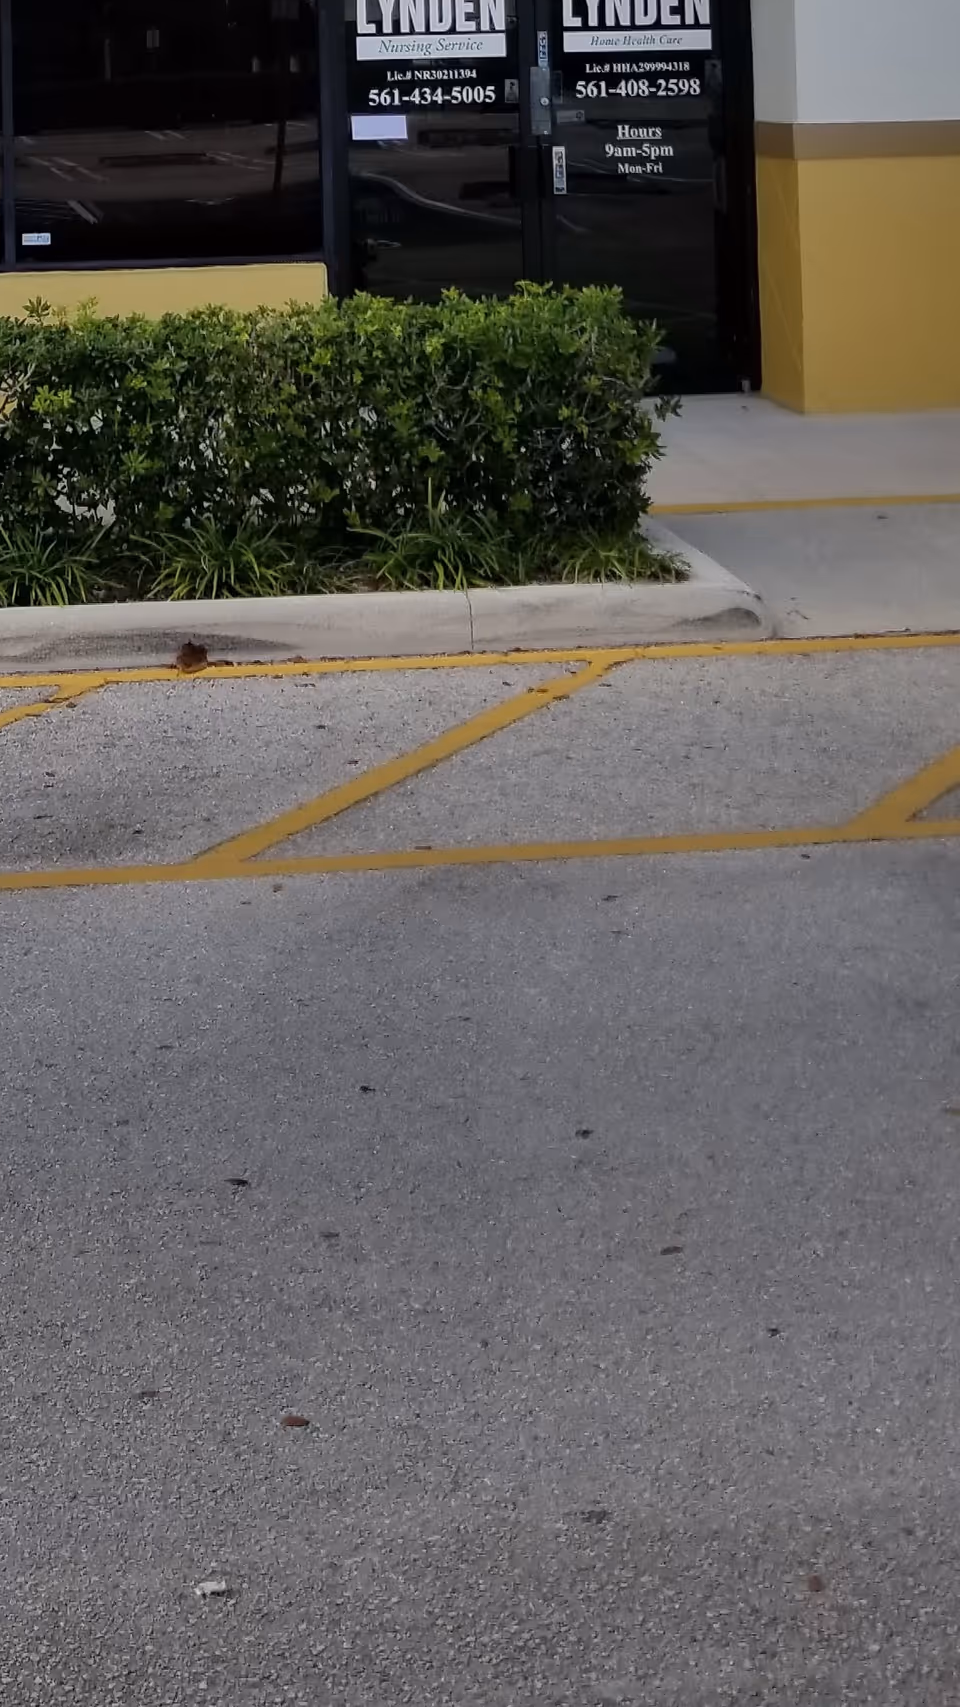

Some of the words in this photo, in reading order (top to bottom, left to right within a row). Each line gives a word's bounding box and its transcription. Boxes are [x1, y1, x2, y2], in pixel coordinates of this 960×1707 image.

[378, 40, 432, 56] Nursing
[436, 38, 483, 51] Service
[590, 36, 619, 46] Home
[623, 35, 656, 46] Health
[659, 35, 683, 44] Care
[613, 62, 690, 73] HHA299994318
[368, 86, 496, 106] 561-434-5005
[575, 79, 701, 98] 561-408-2598
[617, 125, 662, 140] Hours
[605, 144, 674, 159] 9am-5pm
[618, 163, 663, 174] Mon-Fri
